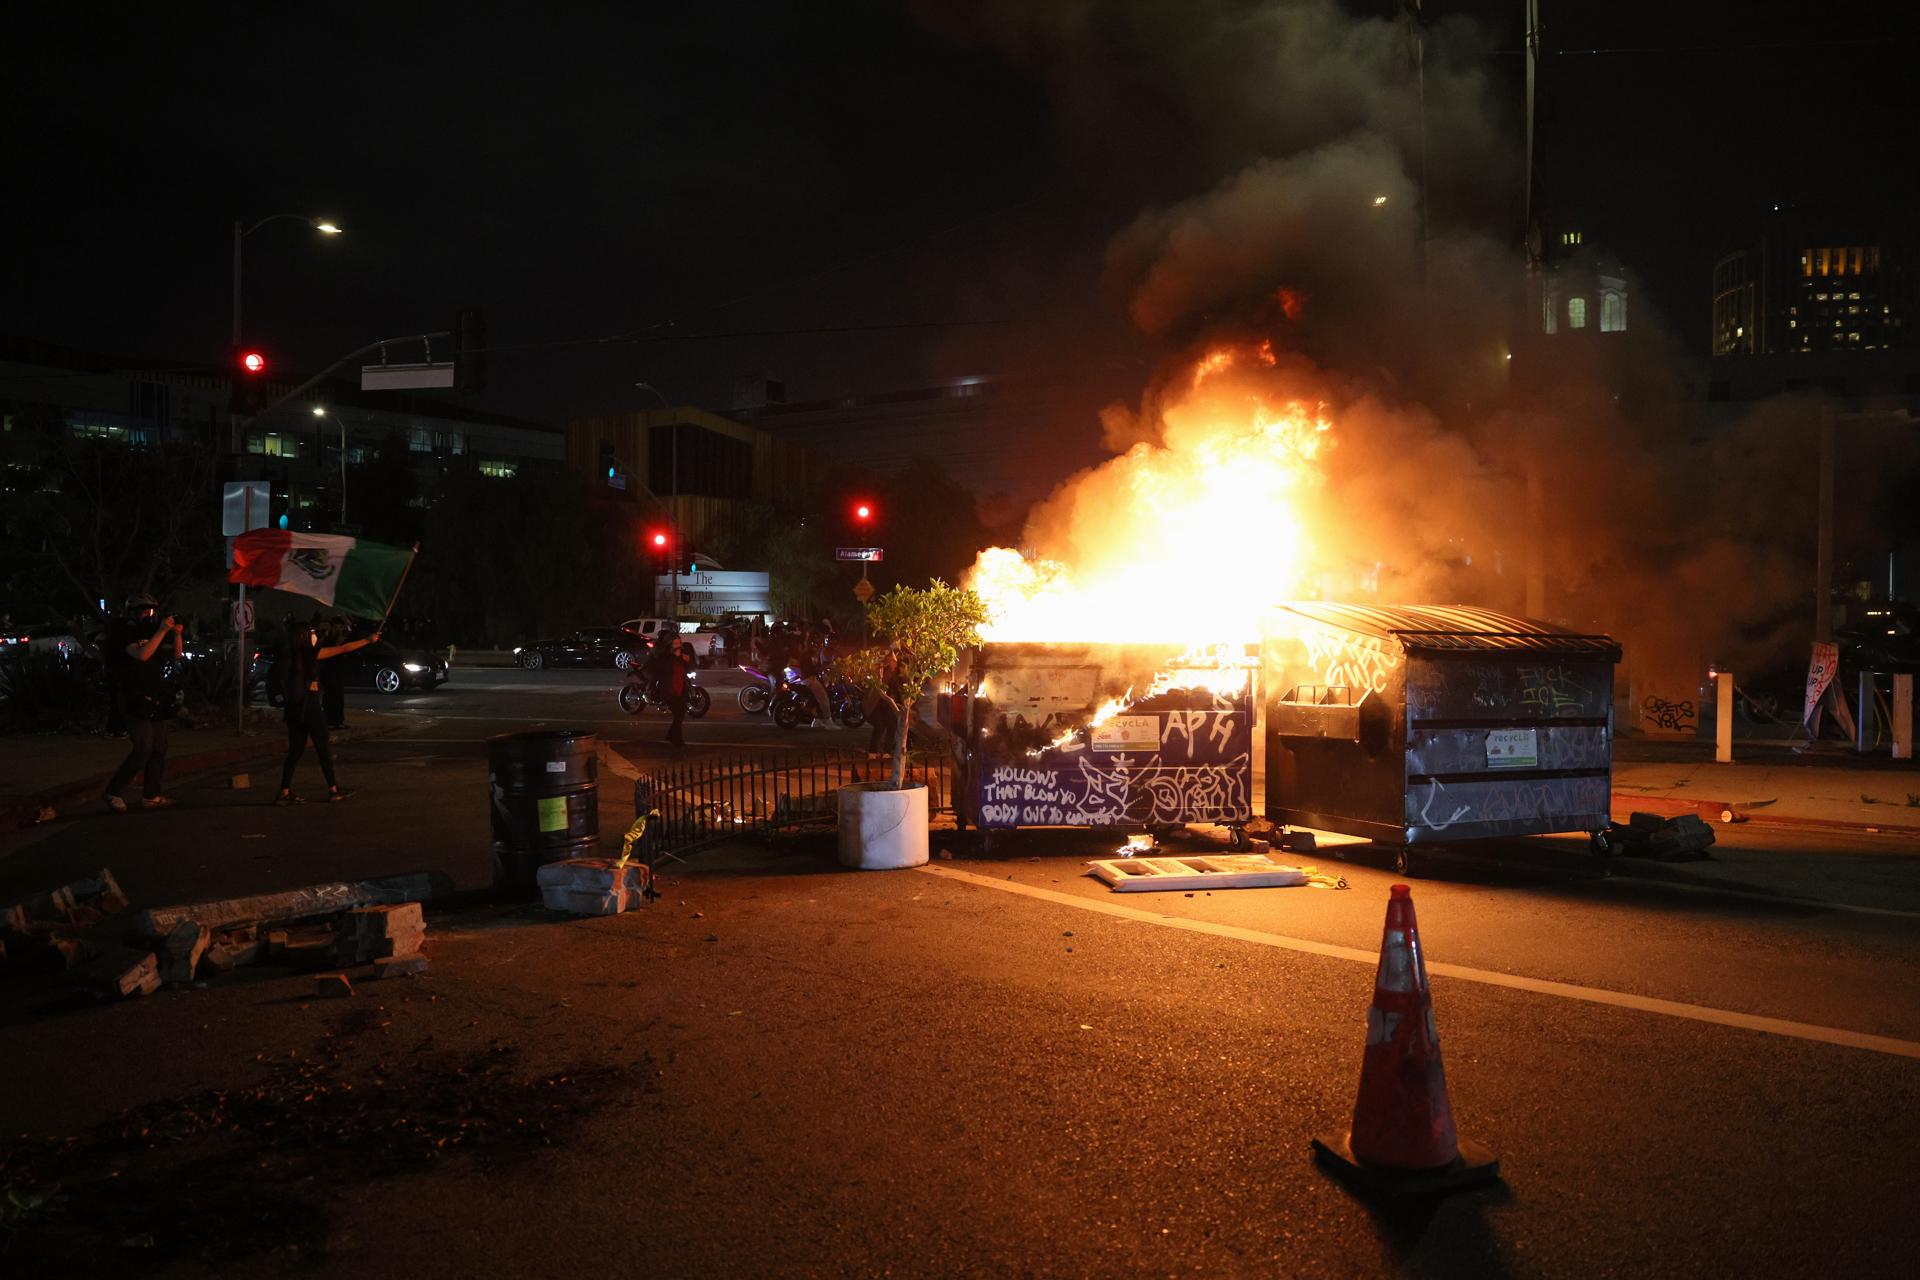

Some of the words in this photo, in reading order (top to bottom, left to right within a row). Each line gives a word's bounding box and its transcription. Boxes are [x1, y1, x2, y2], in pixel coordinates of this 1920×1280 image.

[696, 572, 713, 584] The
[663, 587, 713, 600] Cornia
[992, 767, 1059, 789] HOLLOWS
[984, 783, 1022, 802] THAT
[1024, 784, 1059, 802] BLOW
[982, 803, 1019, 823] BODY
